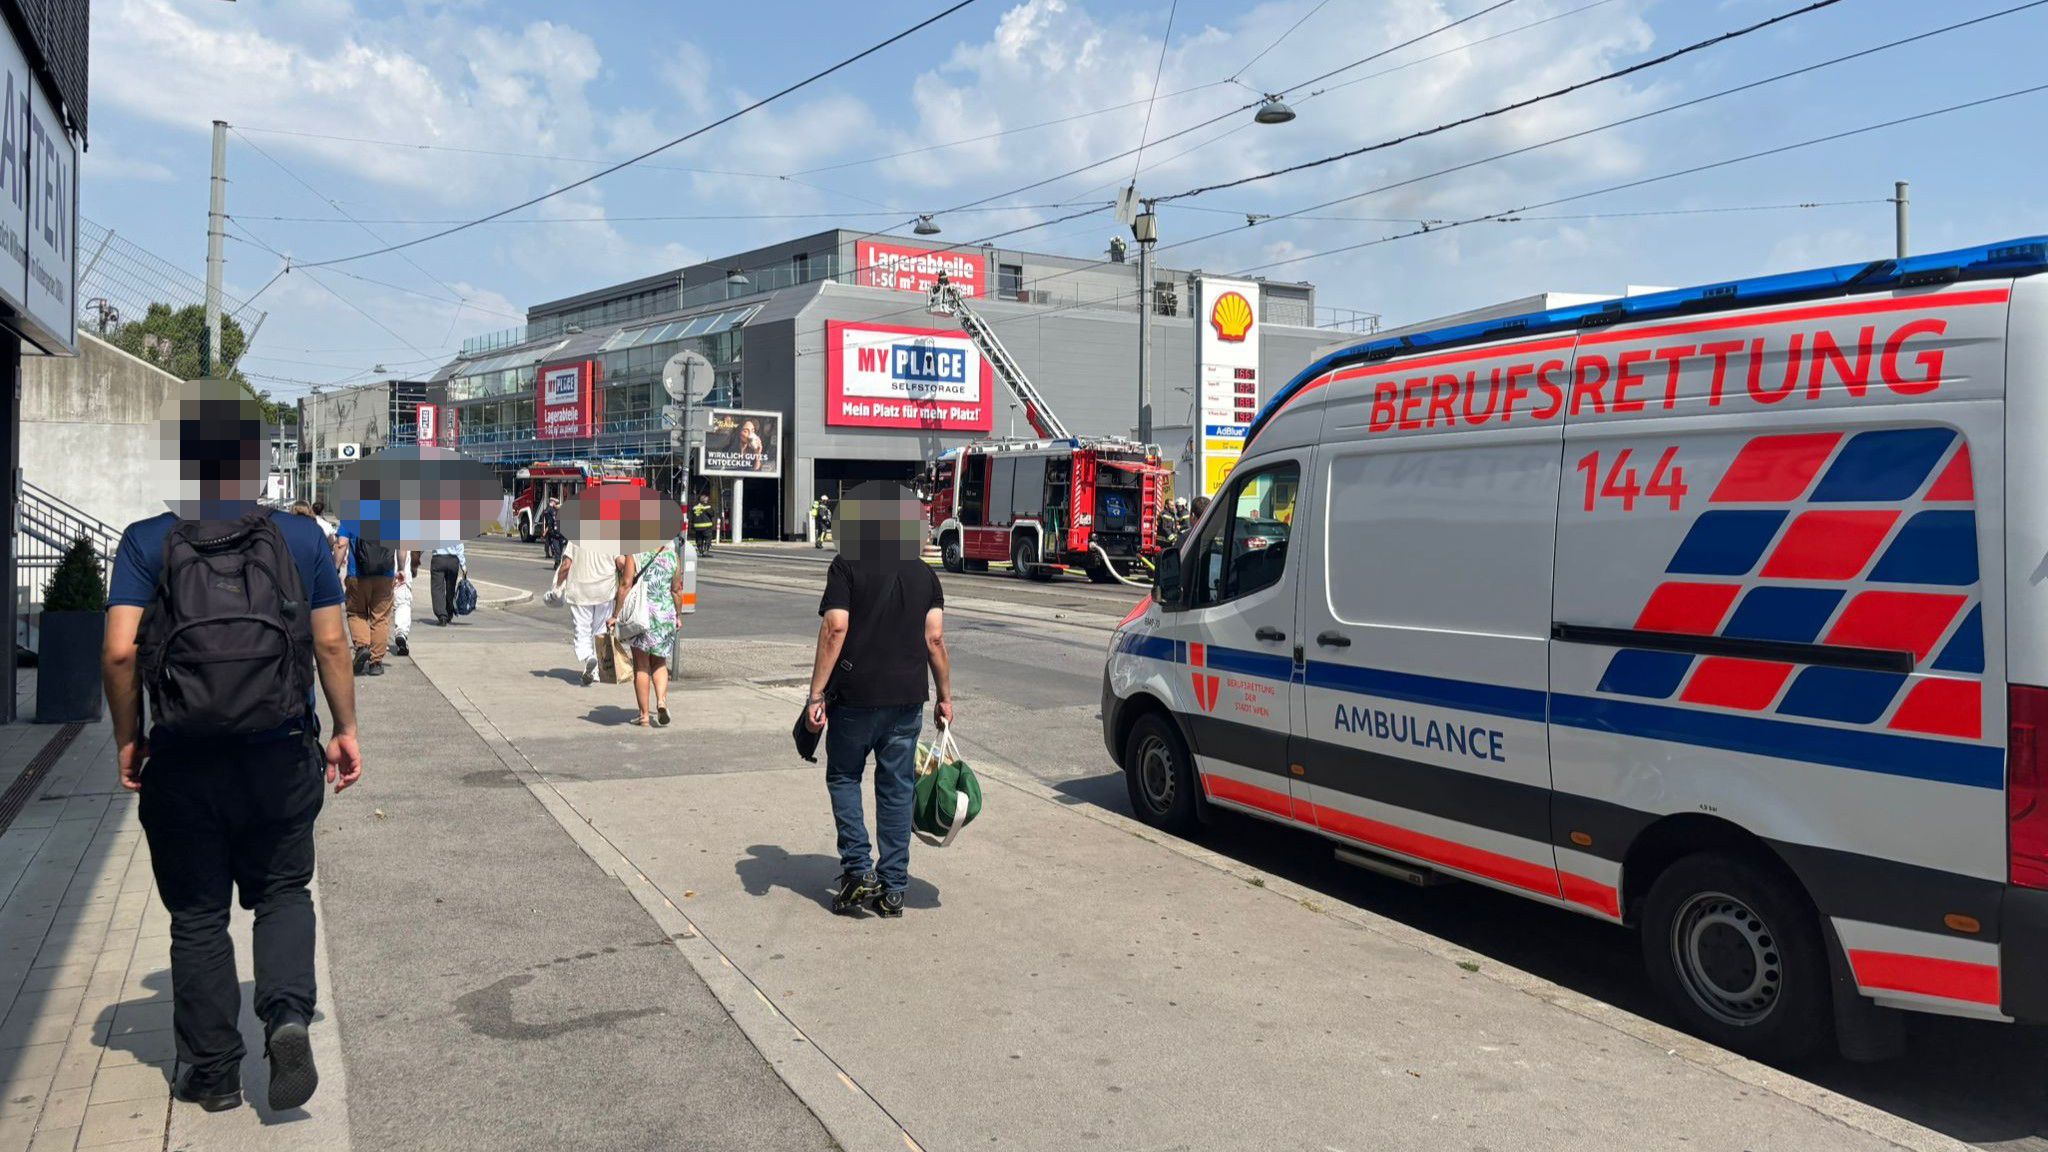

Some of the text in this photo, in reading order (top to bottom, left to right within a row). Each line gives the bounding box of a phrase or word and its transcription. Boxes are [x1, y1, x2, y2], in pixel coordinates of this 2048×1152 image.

[869, 246, 974, 279] Lagerabteile
[858, 347, 962, 378] MY PLACE
[1368, 318, 1947, 433] BERUFSRETTUNG
[891, 382, 965, 394] SELFSTORAGE
[842, 402, 870, 416] Mein
[873, 403, 899, 418] Platz
[902, 405, 918, 419] für
[920, 406, 947, 420] mehr
[708, 451, 768, 461] WIRKLICH GUTES
[1576, 446, 1688, 512] 144
[1334, 703, 1506, 763] AMBULANCE
